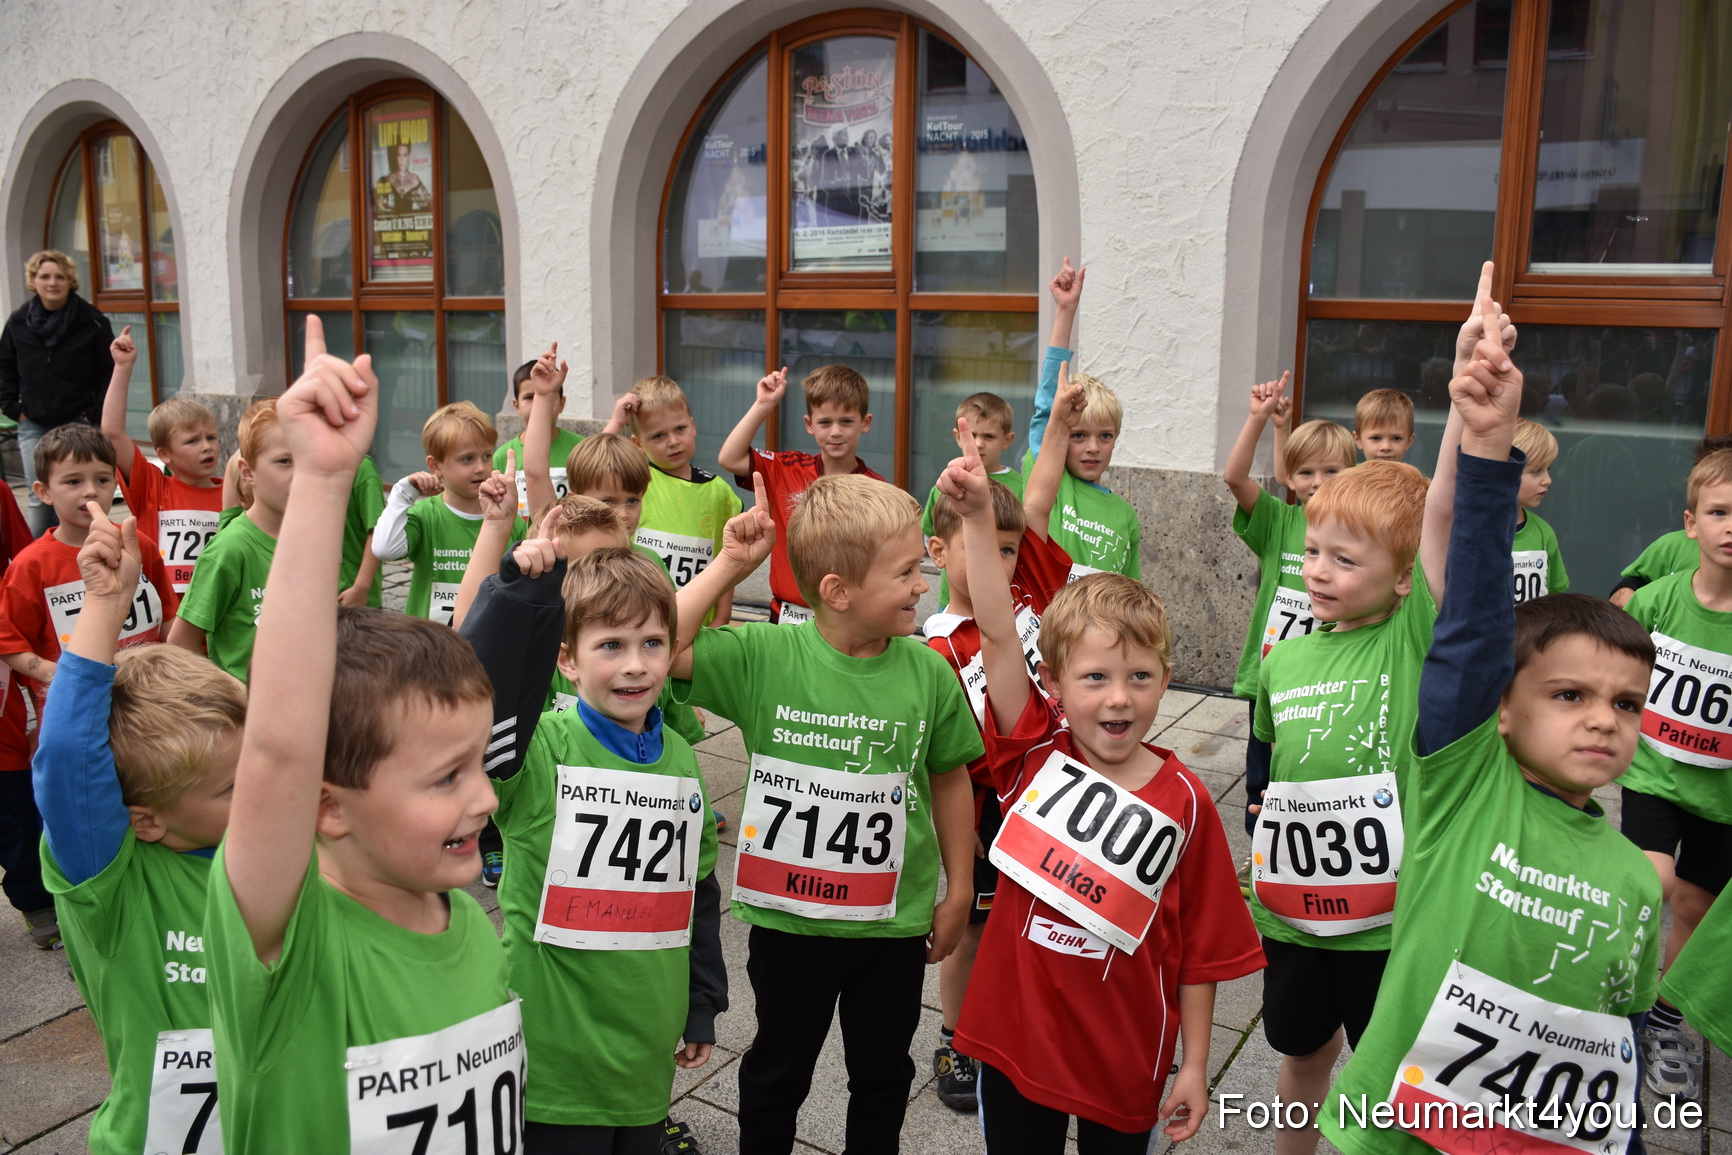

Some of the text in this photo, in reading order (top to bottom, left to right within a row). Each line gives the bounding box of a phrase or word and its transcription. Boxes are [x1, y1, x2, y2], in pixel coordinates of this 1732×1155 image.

[806, 107, 843, 122] BUENA
[927, 122, 963, 131] KulTour
[927, 132, 958, 142] NACHT
[971, 129, 988, 140] 2015
[161, 519, 186, 527] PARTL
[637, 536, 705, 554] PARTL Neumarkt
[1275, 596, 1305, 611] PARTL
[1649, 664, 1732, 728] 706
[776, 705, 887, 731] Neumarkter
[772, 728, 863, 755] Stadtlauf
[1658, 722, 1722, 753] Patrick
[561, 784, 620, 804] PARTL
[753, 769, 886, 804] PARTL Neumarkt
[1288, 795, 1366, 813] Neumarkt
[762, 795, 893, 865] 7143
[1036, 763, 1177, 885] 7000
[575, 813, 688, 882] 7421
[1263, 817, 1389, 877] 7039
[786, 872, 849, 900] Kilian
[1040, 847, 1107, 904] Lukas
[1303, 894, 1349, 914] Finn
[1047, 930, 1087, 948] DEHN
[1445, 983, 1616, 1058] PARTL Neumarkt
[359, 1059, 451, 1101] PARTL
[1434, 1021, 1619, 1141] 7408
